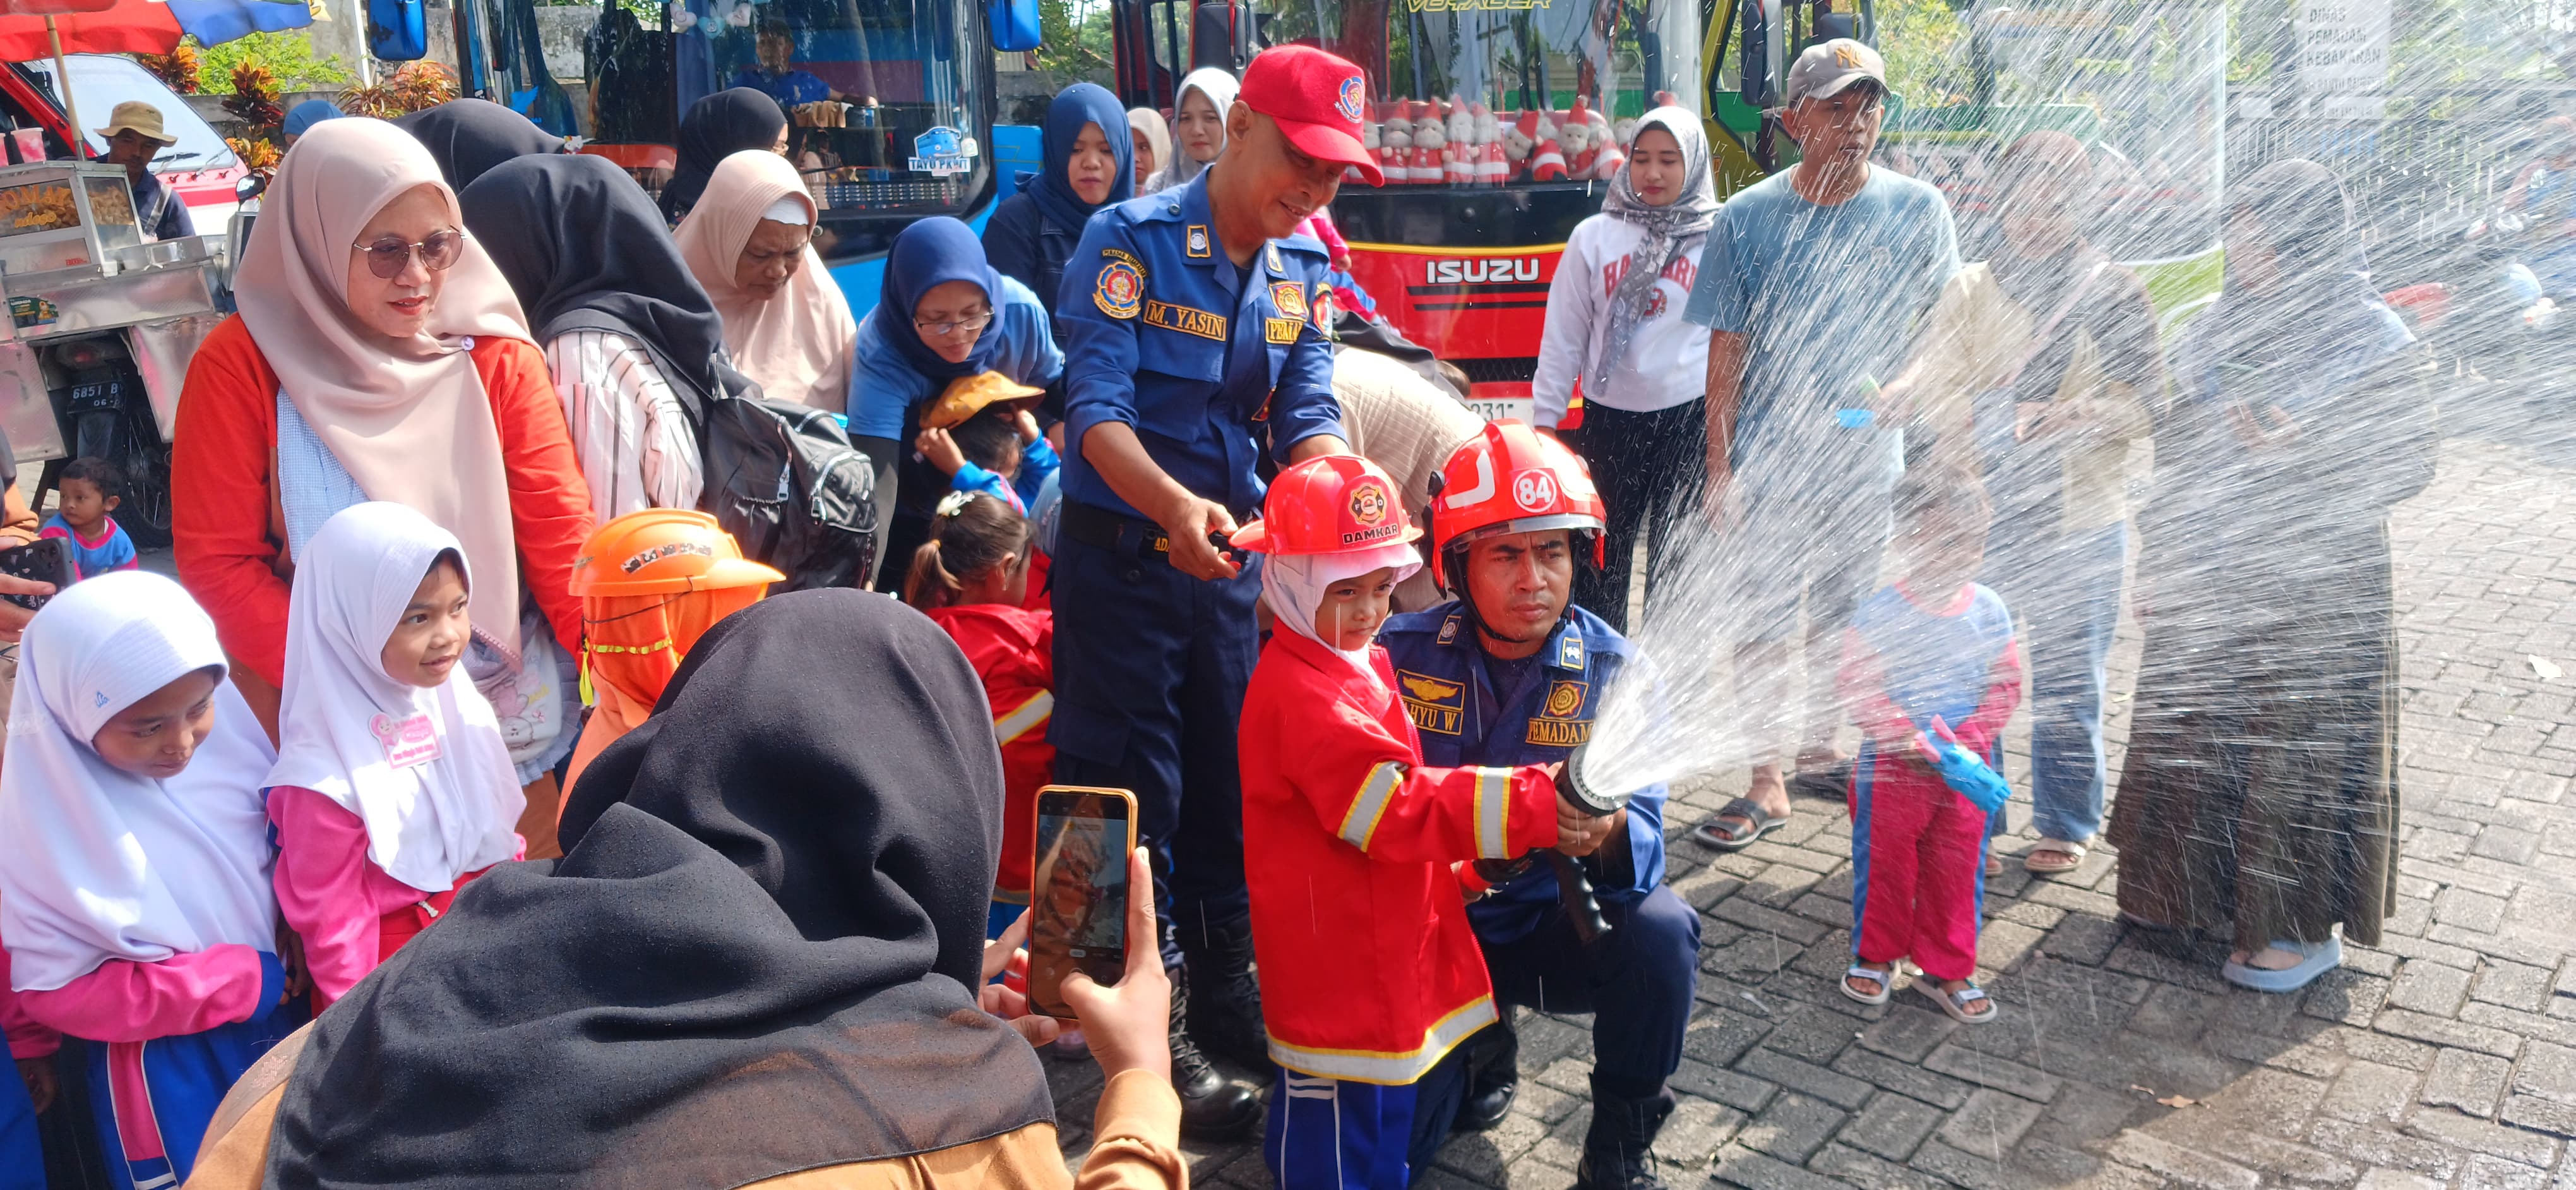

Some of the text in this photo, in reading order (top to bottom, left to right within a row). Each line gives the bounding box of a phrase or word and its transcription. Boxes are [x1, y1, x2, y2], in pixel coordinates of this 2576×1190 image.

[1427, 258, 1539, 284] ISUZU
[1148, 303, 1169, 325] M.
[1176, 308, 1224, 337] YASIN
[73, 385, 102, 399] 6851
[1519, 476, 1552, 506] 84
[1343, 524, 1398, 544] DAMKAR
[1445, 711, 1457, 731] W
[1527, 722, 1594, 743] PEMADAM
